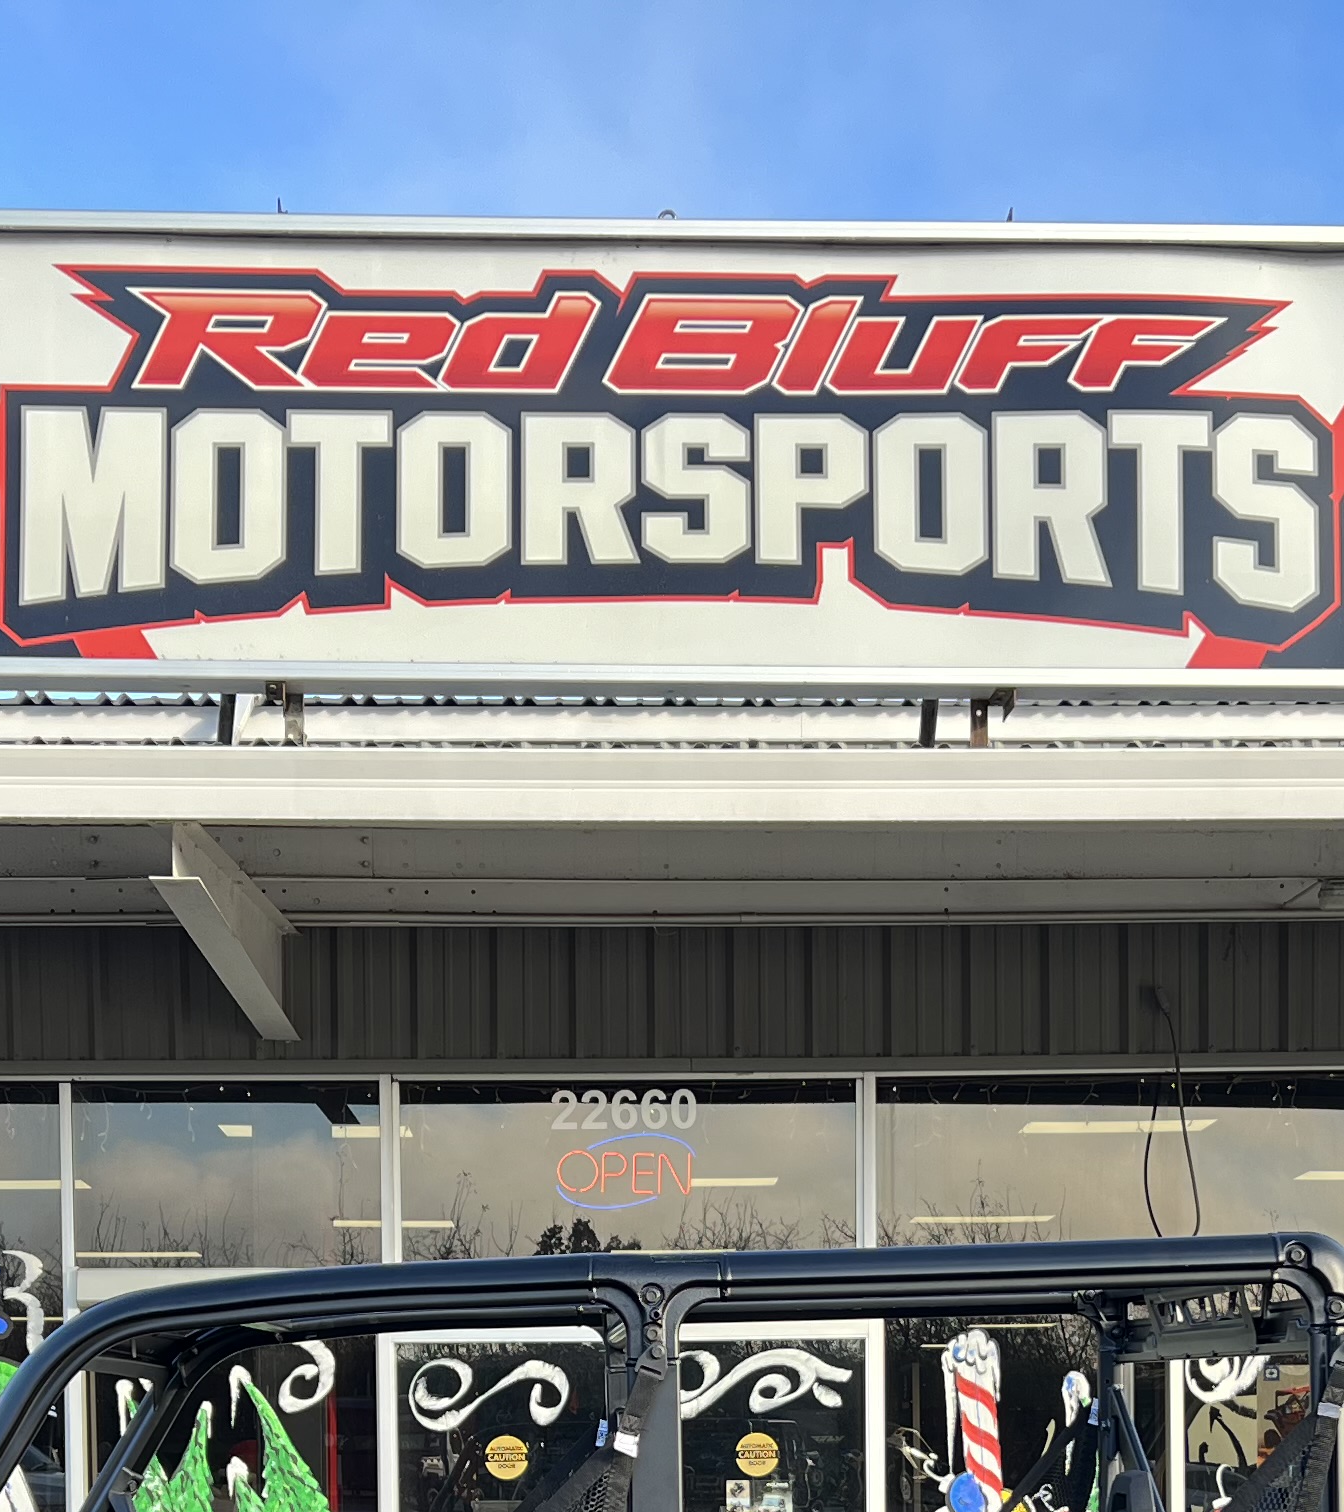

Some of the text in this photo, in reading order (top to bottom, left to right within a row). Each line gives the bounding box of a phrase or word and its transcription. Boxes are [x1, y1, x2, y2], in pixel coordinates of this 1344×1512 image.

[127, 287, 601, 393] Red
[19, 405, 1319, 612] MOTORSPORTS
[551, 1089, 697, 1131] 22660
[557, 1150, 692, 1195] OPEN
[487, 1453, 526, 1462] CAUTION
[738, 1450, 776, 1459] CAUTION
